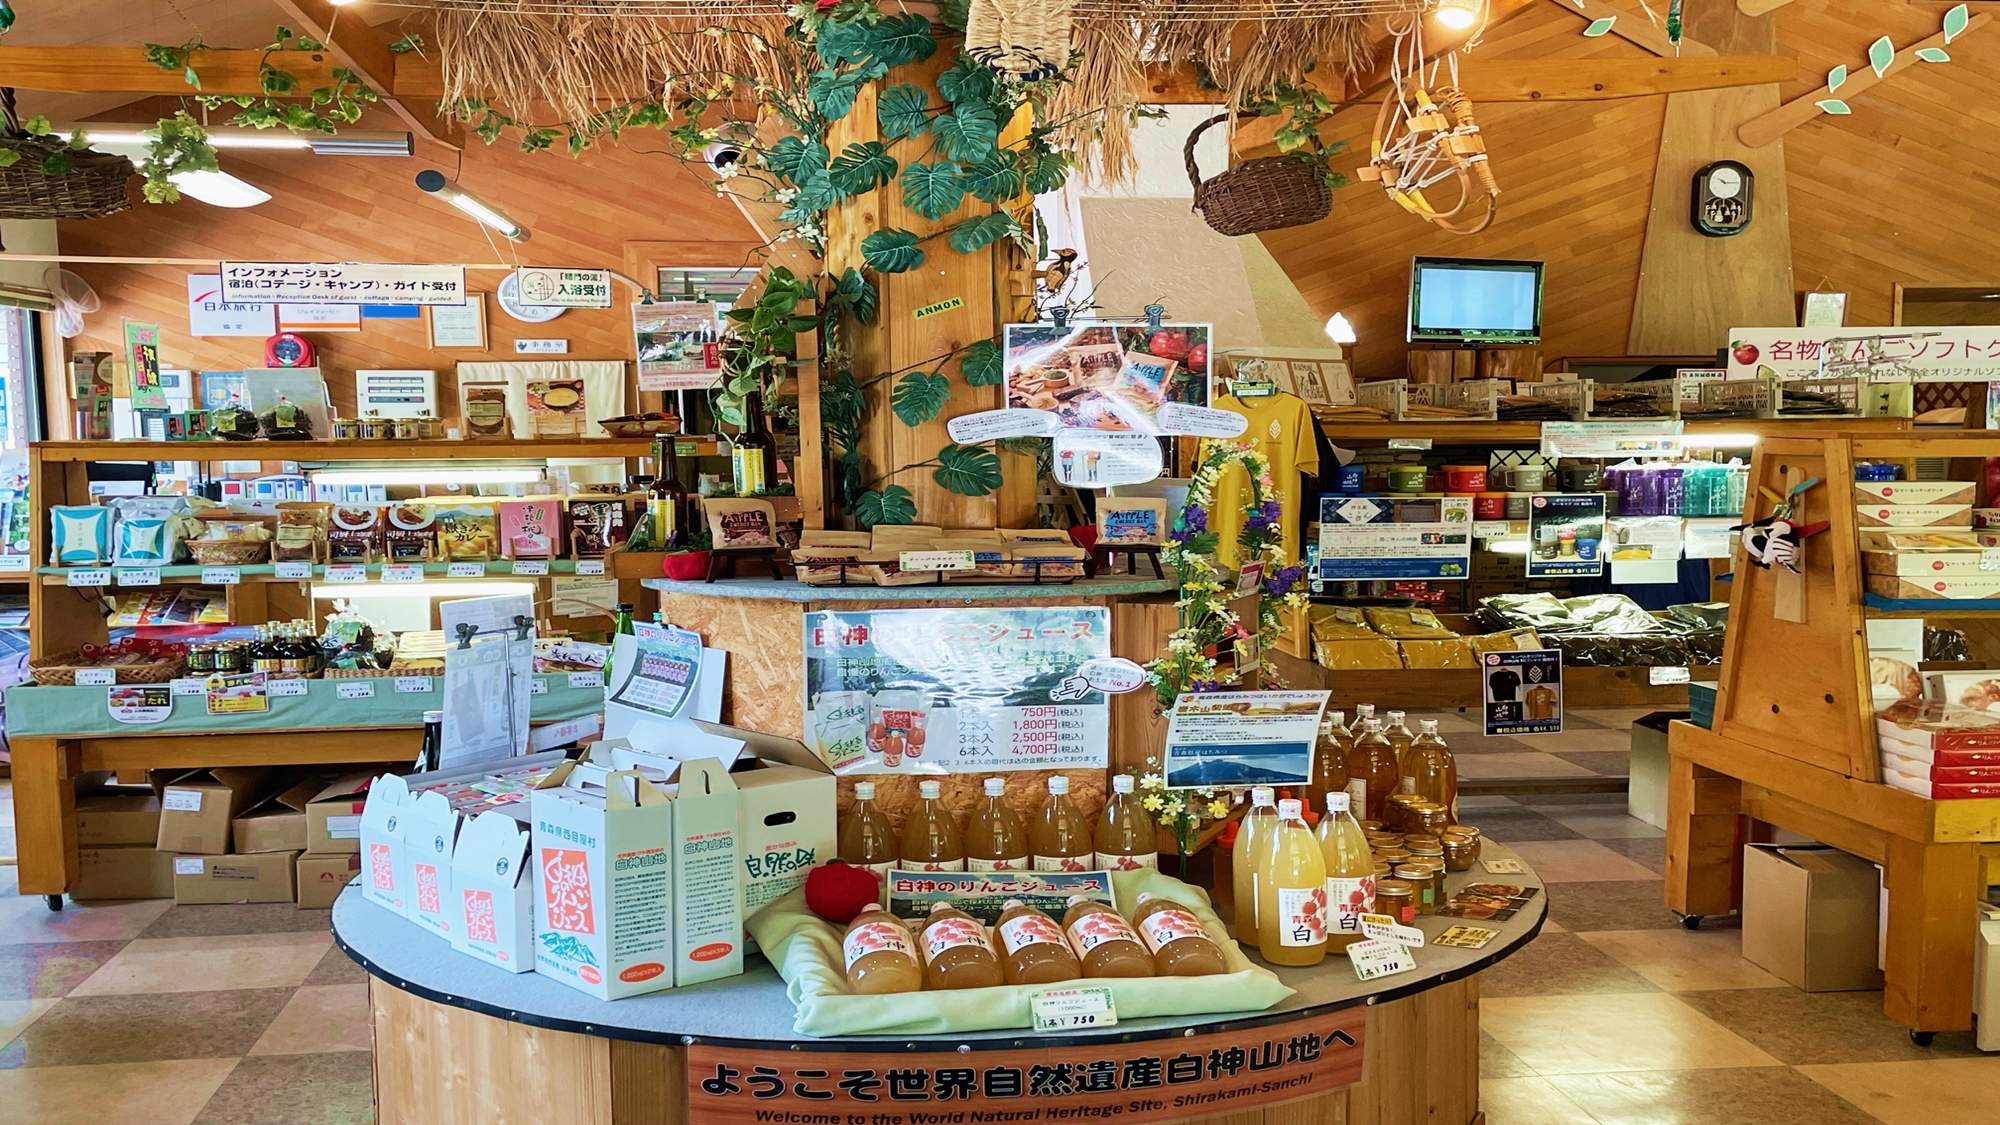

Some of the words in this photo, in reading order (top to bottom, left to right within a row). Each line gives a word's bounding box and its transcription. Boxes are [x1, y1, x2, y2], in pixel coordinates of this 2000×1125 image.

[228, 267, 342, 278] インフォメーション
[558, 284, 606, 296] 入浴受付
[915, 298, 961, 318] ANMON
[455, 534, 489, 542] カレー
[1109, 679, 1131, 687] No.1
[147, 697, 167, 706] たれ
[959, 721, 994, 732] 2本入
[959, 734, 994, 744] 3本入
[959, 746, 994, 757] 6本入
[539, 821, 596, 848] 青森県西目屋村
[684, 836, 733, 855] 白神山地
[615, 853, 667, 871] 白神山地
[896, 879, 1102, 893] 白神のりんごジュース
[1339, 914, 1358, 931] 白
[1293, 925, 1312, 943] 白
[1383, 962, 1399, 972] 750
[1073, 1015, 1095, 1024] 750
[701, 1029, 1355, 1102] ようこそ世界自然遺産白神山地へ
[755, 1109, 833, 1124] Welcome
[846, 1111, 866, 1125] to
[872, 1113, 902, 1125] the
[909, 1110, 964, 1124] World
[970, 1107, 1040, 1123] Natural
[1047, 1104, 1123, 1120] Heritage
[1128, 1100, 1167, 1112] Site,
[1173, 1072, 1314, 1108] Shirakami-Sanchi
